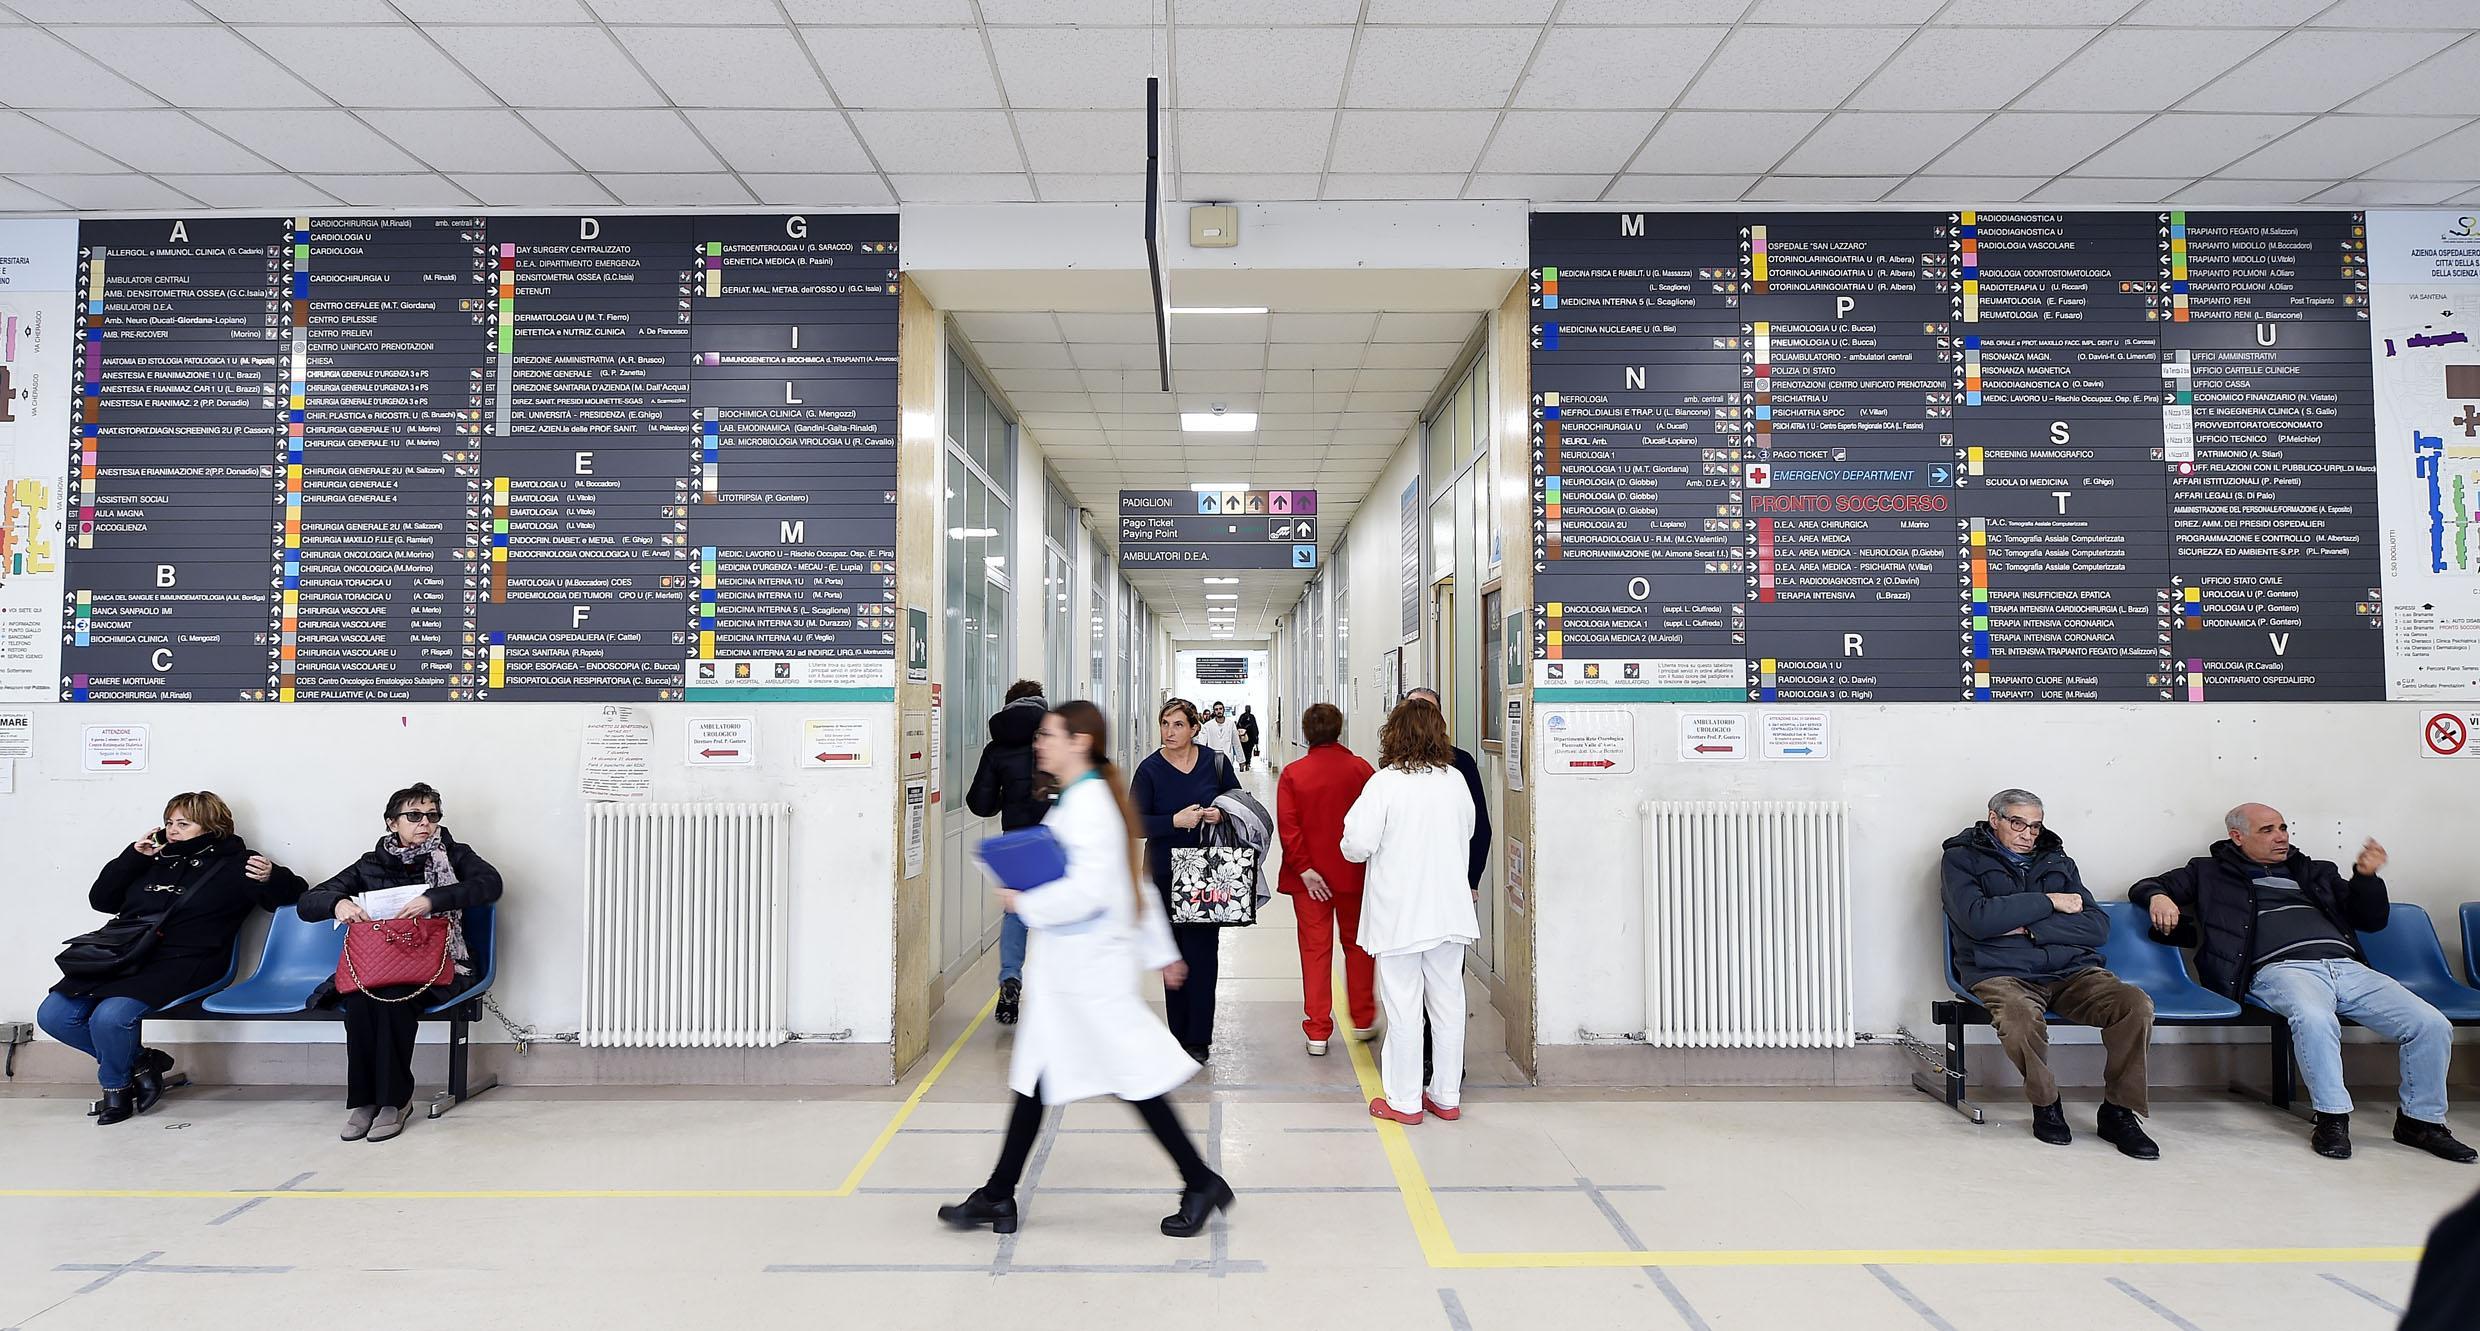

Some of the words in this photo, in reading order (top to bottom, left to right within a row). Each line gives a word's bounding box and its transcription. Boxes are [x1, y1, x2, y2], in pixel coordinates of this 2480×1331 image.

[580, 218, 600, 240] D
[786, 216, 807, 238] G
[1622, 214, 1644, 236] M
[169, 220, 189, 242] A
[516, 246, 532, 254] DAY
[532, 246, 570, 254] SURGERY
[570, 246, 631, 254] CENTRALIZZATO
[1768, 242, 1809, 250] OSPEDALE
[1810, 242, 1828, 250] "SAN
[1830, 242, 1867, 250] LAZZARO"
[1978, 242, 2027, 250] RADIOLOGIA
[2028, 242, 2075, 250] VASCOLARE
[310, 247, 364, 255] CARDIOLOGIA
[2411, 249, 2437, 257] AZIENDA
[797, 257, 808, 266] (B.
[2454, 259, 2475, 267] DELLA
[2232, 269, 2267, 277] POLMONI
[2431, 269, 2451, 277] DELLA
[2452, 269, 2478, 277] SCIENZA
[106, 276, 152, 284] AMBULATORI
[154, 276, 190, 284] CENTRALI
[515, 287, 551, 295] DETENUTI
[1979, 297, 2042, 305] REUMATOLOGIA
[2046, 297, 2057, 306] (E.
[2058, 297, 2086, 305] Fusaro)
[153, 303, 174, 311] D.E.A.
[1837, 296, 1854, 318] P
[308, 316, 339, 324] CENTRO
[341, 316, 378, 324] EPILESSIE
[1770, 324, 1830, 332] PNEUMOLOGIA
[1838, 324, 1850, 333] (C.
[1851, 324, 1876, 332] Bucca)
[308, 330, 339, 338] CENTRO
[792, 326, 798, 348] I
[2257, 324, 2276, 346] U
[308, 343, 338, 351] CENTRO
[381, 342, 434, 350] PRENOTAZIONI
[2192, 352, 2216, 360] UFFICI
[2218, 352, 2277, 360] AMMINISTRATIVI
[306, 357, 334, 365] CHIESA
[1770, 367, 1800, 375] POLIZIA
[1626, 367, 1645, 389] N
[2193, 380, 2223, 388] UFFICIO
[2225, 380, 2251, 388] CASSA
[786, 382, 802, 404] L
[2050, 421, 2070, 444] S
[1772, 450, 1797, 458] PAGO
[1798, 450, 1828, 458] TICKET
[1984, 450, 2028, 458] SCREENING
[2030, 450, 2094, 458] MAMMOGRAFICO
[576, 452, 593, 474] E
[1773, 470, 1841, 480] EMERGENCY
[1842, 470, 1915, 480] DEPARTMENT
[510, 480, 559, 488] EMATOLOGIA
[96, 496, 138, 504] ASSISTENTI
[718, 494, 763, 502] LITOTRIPSIA
[764, 494, 774, 503] (P.
[775, 494, 809, 502] Gontero)
[1562, 492, 1616, 500] NEUROLOGIA
[1617, 492, 1628, 501] (D.
[1629, 492, 1658, 500] Giobbe)
[1122, 498, 1172, 507] PADIGLIONI
[1750, 494, 1832, 512] PRONTO
[1836, 494, 1948, 512] SOCCORSO
[2052, 492, 2071, 514] T
[96, 524, 148, 532] ACCOGLIENZA
[1123, 518, 1146, 529] Pago
[1148, 518, 1174, 527] Ticket
[781, 521, 804, 543] M
[1123, 529, 1153, 540] Paying
[1155, 529, 1178, 538] Point
[1123, 552, 1180, 560] AMBULATORI
[1184, 552, 1210, 560] D.E.A.
[156, 565, 176, 587] B
[2259, 576, 2283, 584] CIVILE
[1628, 577, 1650, 600] O
[1988, 591, 2020, 599] TERAPIA
[2022, 591, 2078, 599] INSUFFICIENZA
[2080, 591, 2111, 599] EPATICA
[92, 607, 118, 615] BANCA
[119, 607, 160, 615] SANPAOLO
[800, 606, 810, 616] (L.
[812, 606, 850, 616] Scaglione)
[2203, 604, 2246, 612] UROLOGIA
[2247, 604, 2254, 612] U
[2255, 604, 2266, 613] (P.
[2267, 604, 2300, 612] Gontero)
[573, 606, 590, 628] F
[90, 621, 133, 629] BANCOMAT
[1844, 634, 1863, 656] R
[2269, 633, 2289, 656] V
[152, 648, 173, 671] C
[2203, 662, 2244, 670] VIROLOGIA
[2245, 662, 2284, 671] (R.Cavallo)
[89, 677, 121, 685] CAMERE
[122, 677, 166, 685] MORTUARIE
[365, 691, 376, 700] (A.
[1778, 690, 1828, 698] RADIOLOGIA
[1830, 690, 1835, 698] 3
[1838, 690, 1850, 699] (D.
[1851, 690, 1873, 700] Righi)
[0, 718, 28, 727] MARE
